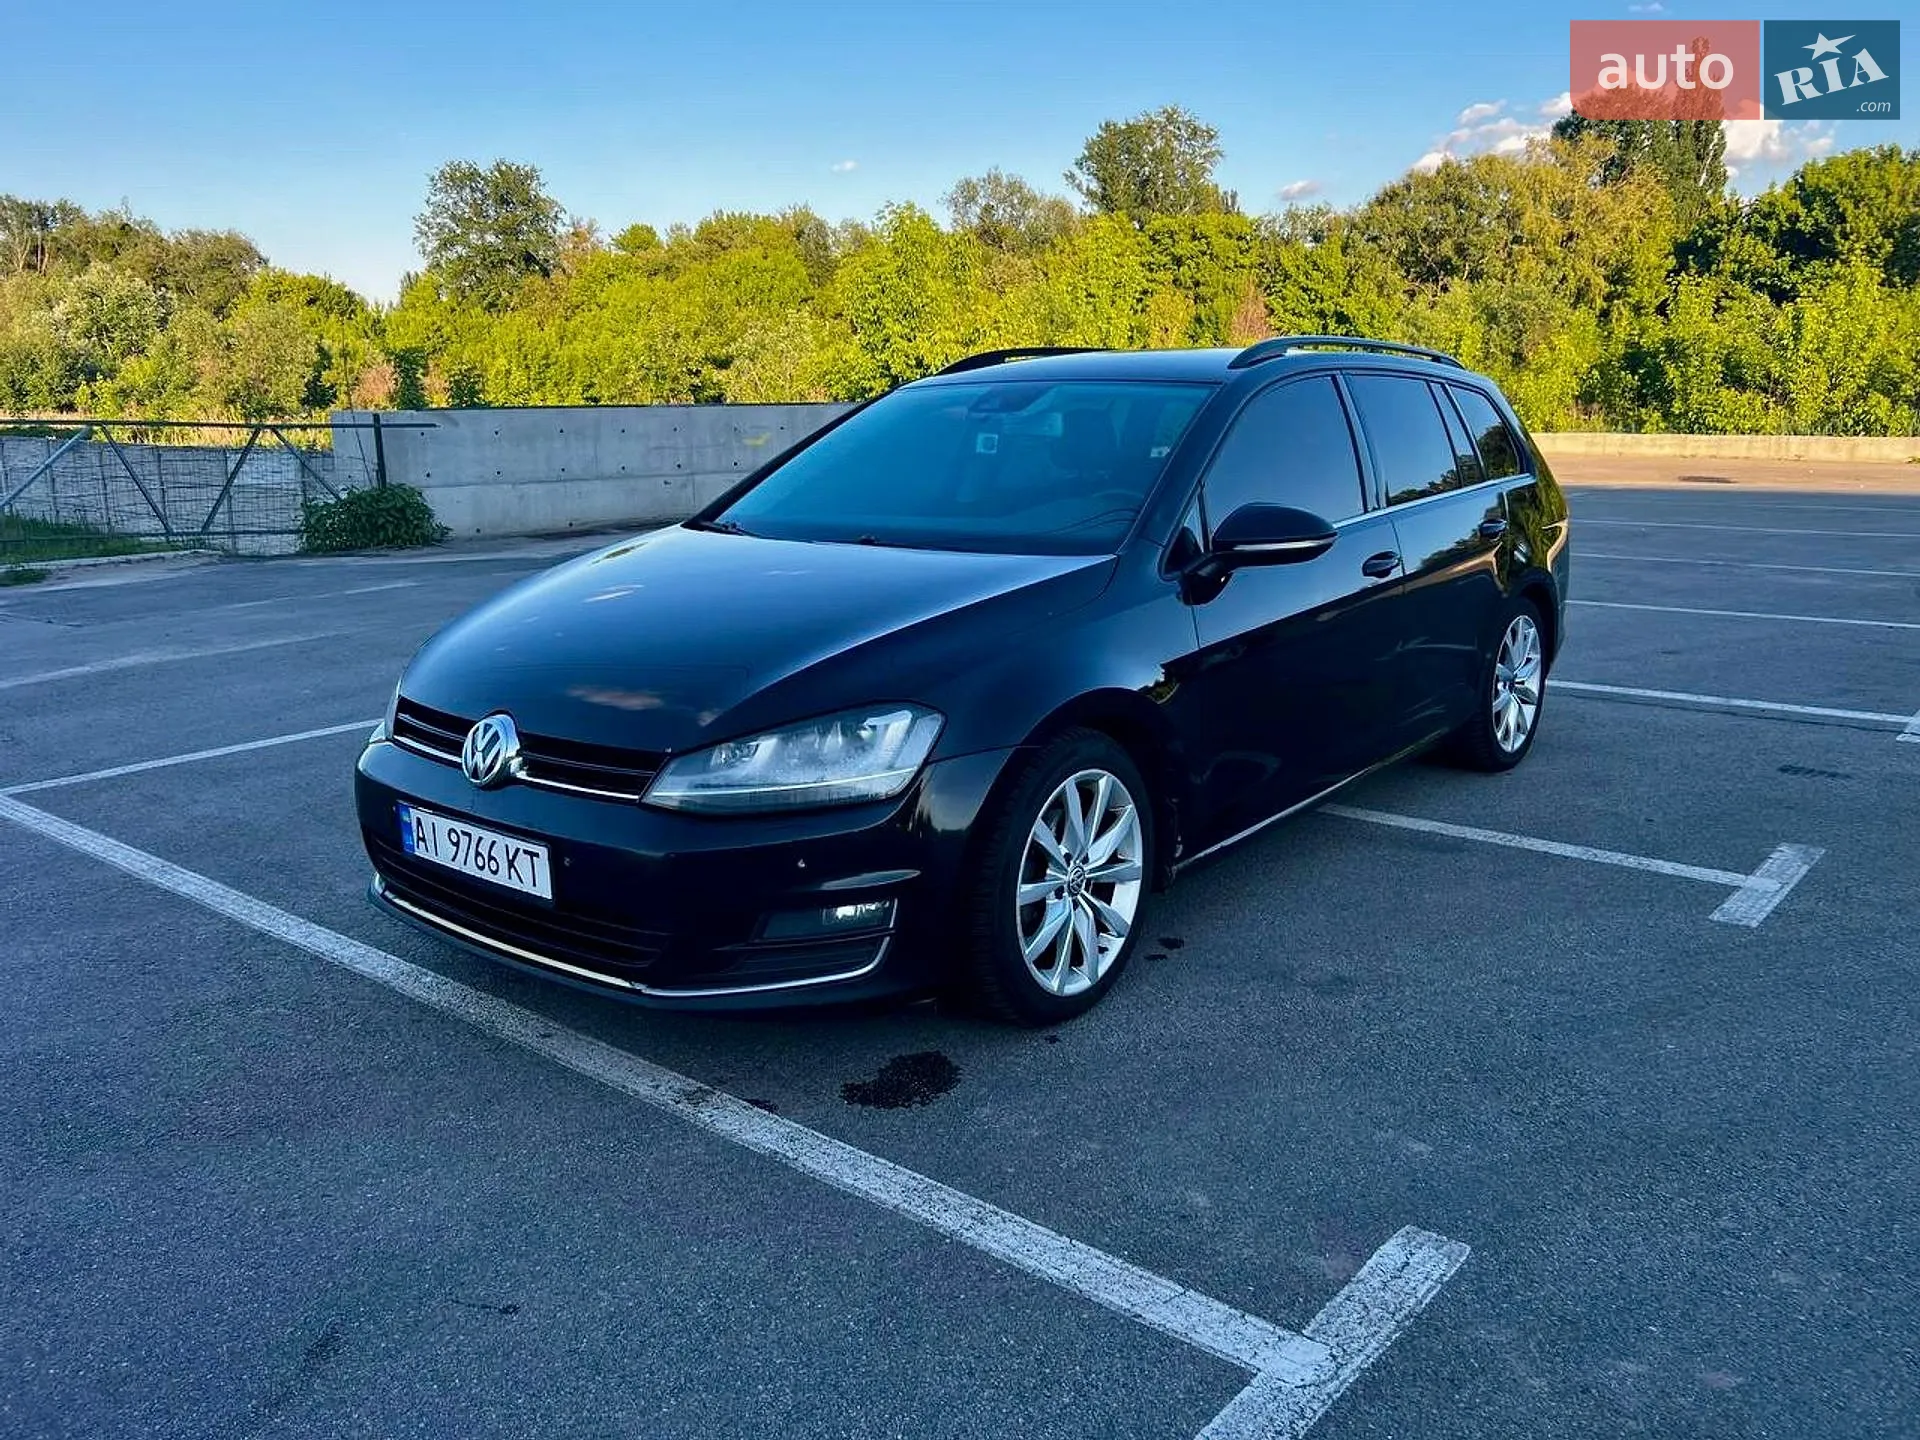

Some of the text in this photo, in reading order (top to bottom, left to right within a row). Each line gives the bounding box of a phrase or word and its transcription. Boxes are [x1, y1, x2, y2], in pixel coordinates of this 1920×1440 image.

[415, 816, 540, 887] AI 9766 KT
